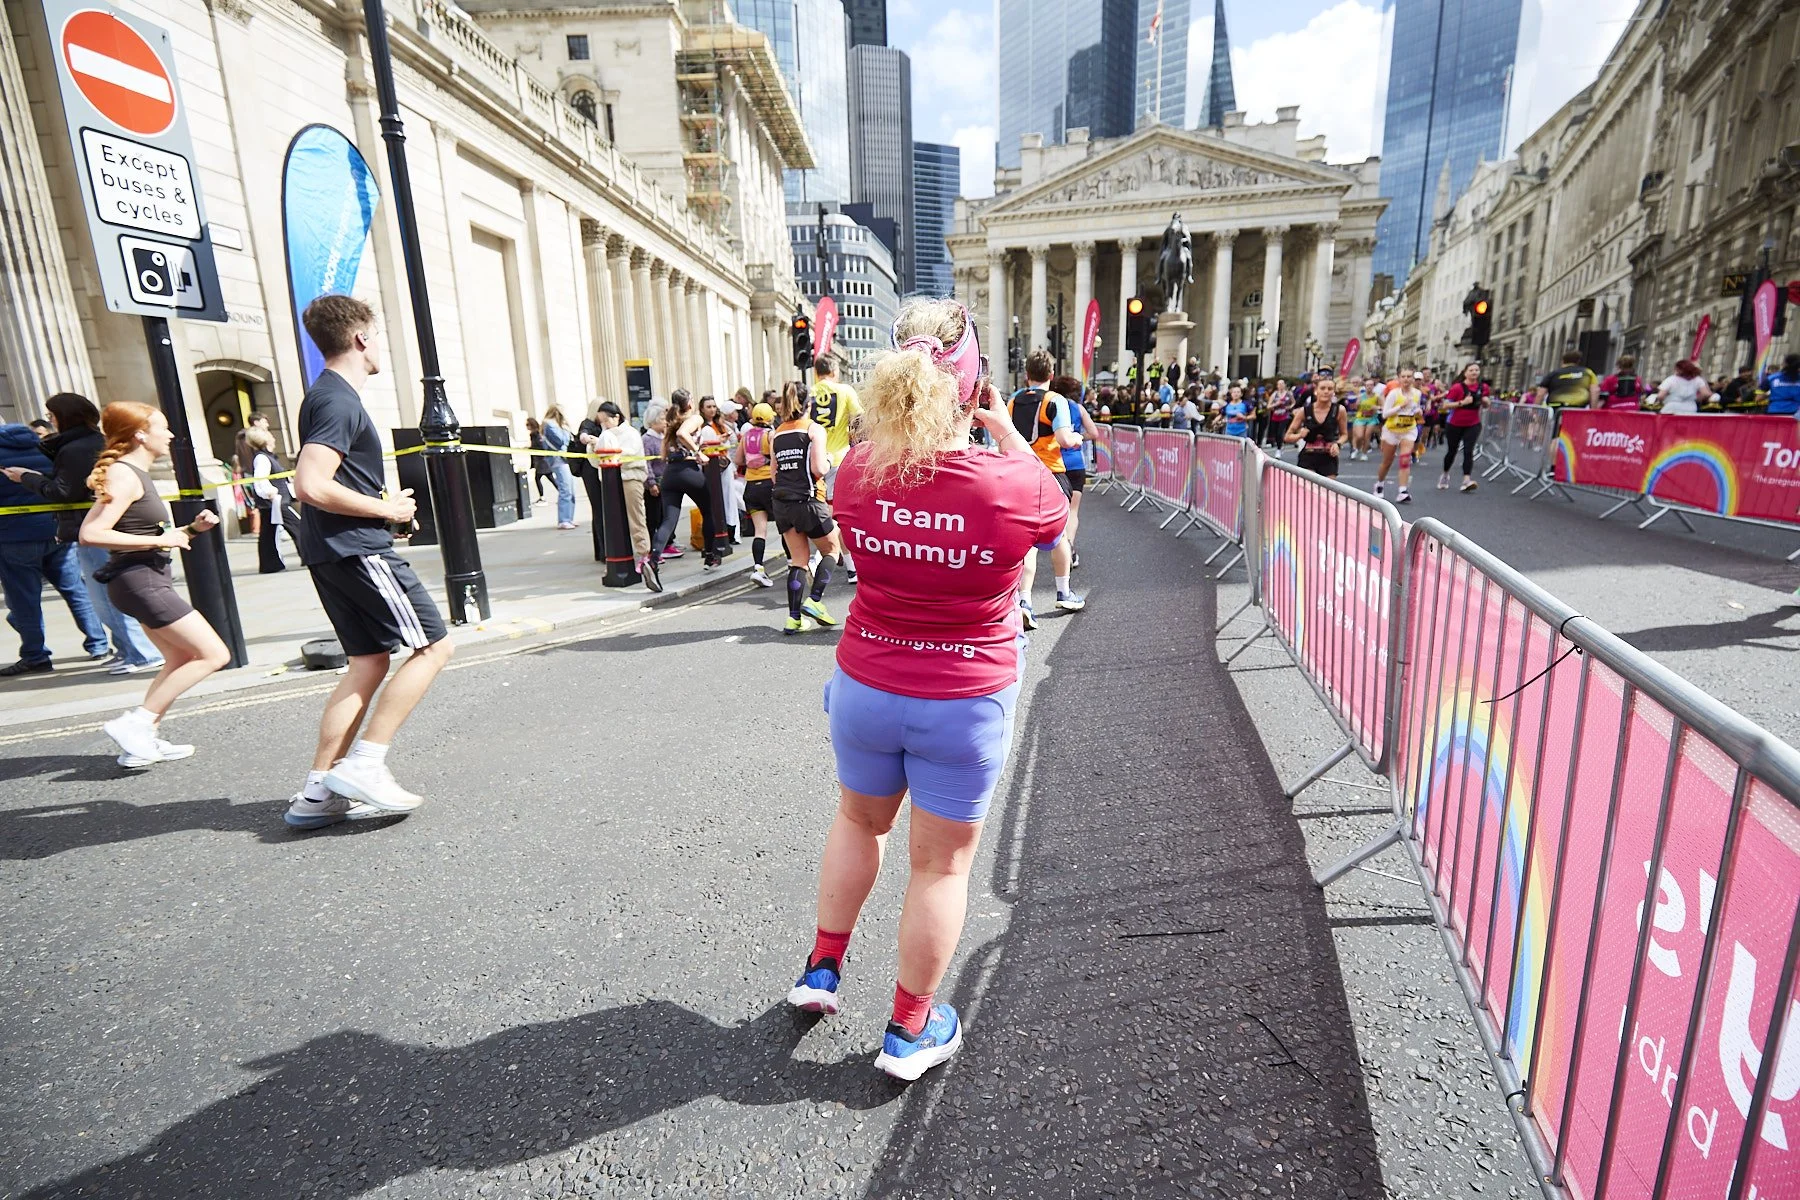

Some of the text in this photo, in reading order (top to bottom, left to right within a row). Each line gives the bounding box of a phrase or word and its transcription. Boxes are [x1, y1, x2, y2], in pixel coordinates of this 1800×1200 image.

[101, 144, 178, 180] Except
[101, 168, 188, 205] buses &
[117, 200, 184, 226] cycles
[875, 499, 966, 533] Team
[850, 526, 996, 570] Tommy's
